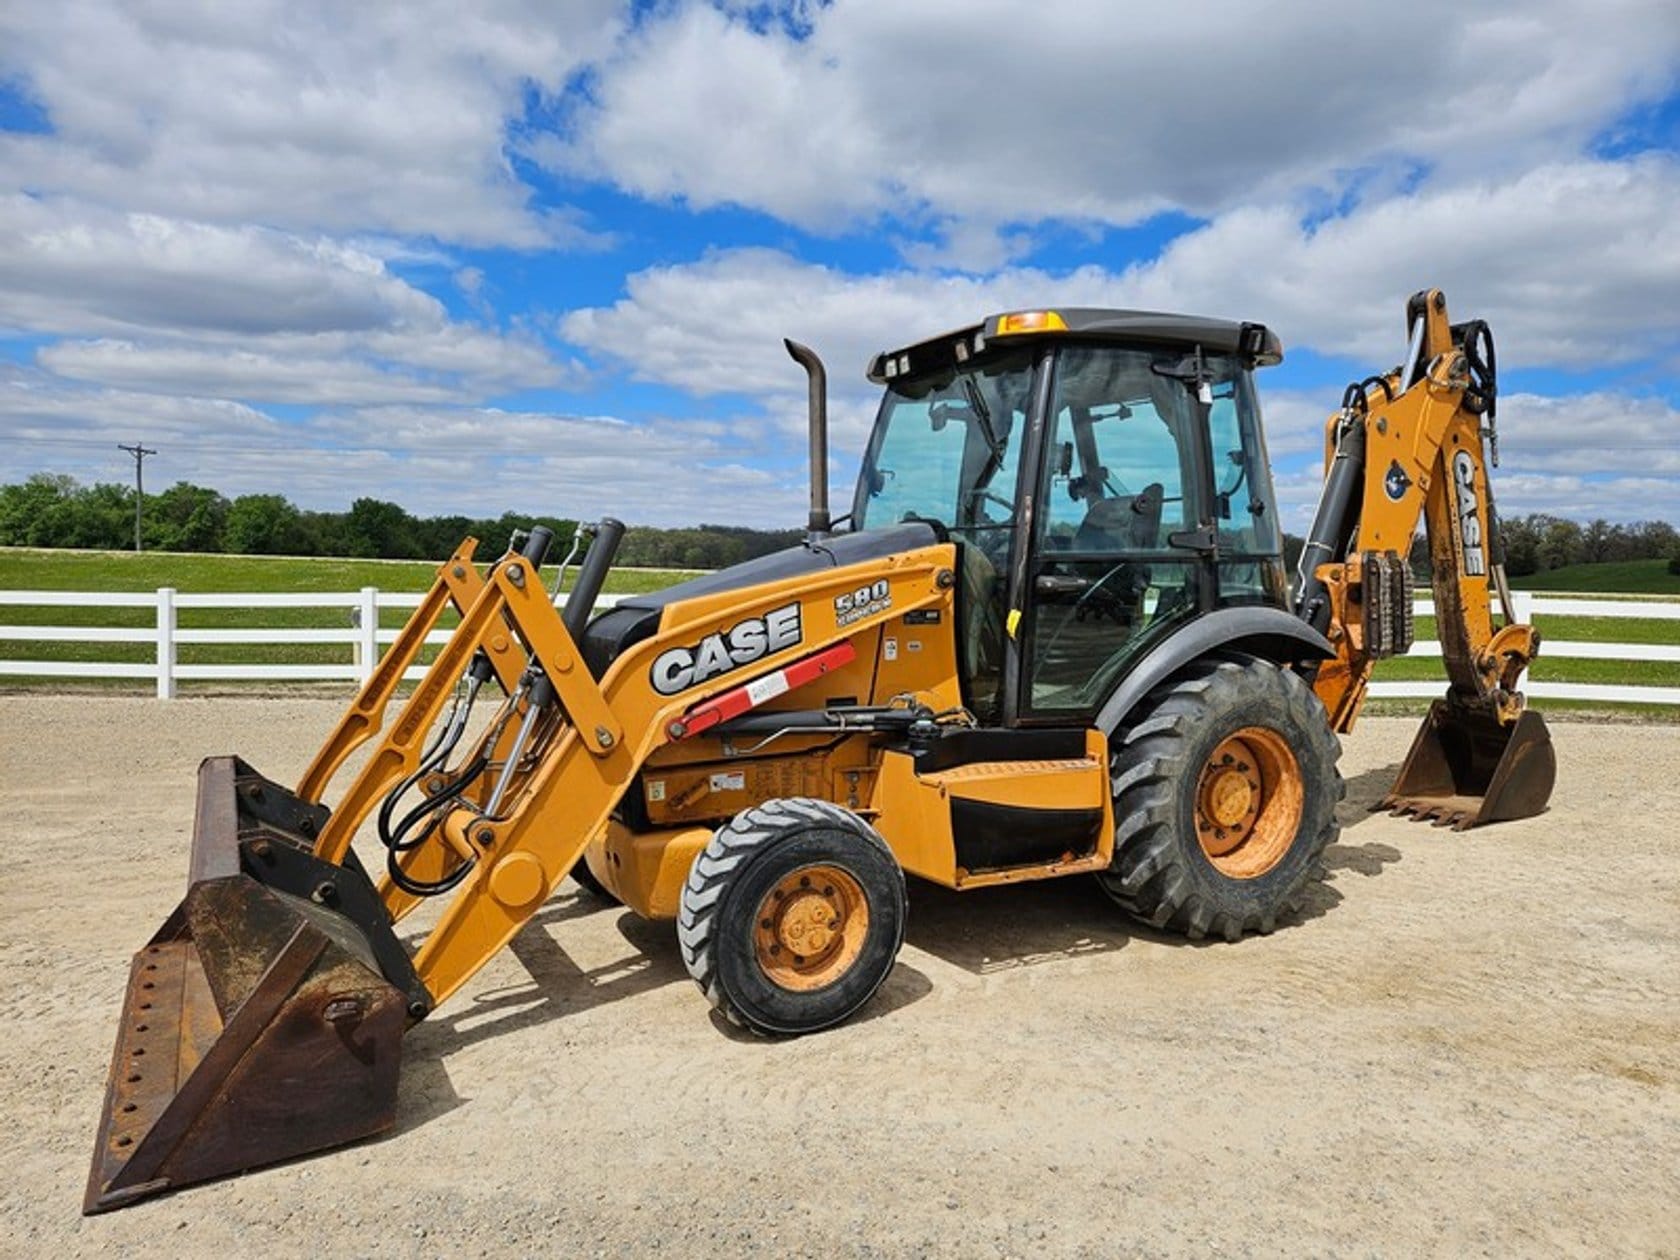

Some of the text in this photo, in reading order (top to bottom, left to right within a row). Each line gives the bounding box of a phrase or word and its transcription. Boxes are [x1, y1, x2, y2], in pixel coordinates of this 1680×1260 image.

[1455, 450, 1485, 575] CASE
[835, 579, 889, 616] 580
[651, 602, 801, 695] CASE
